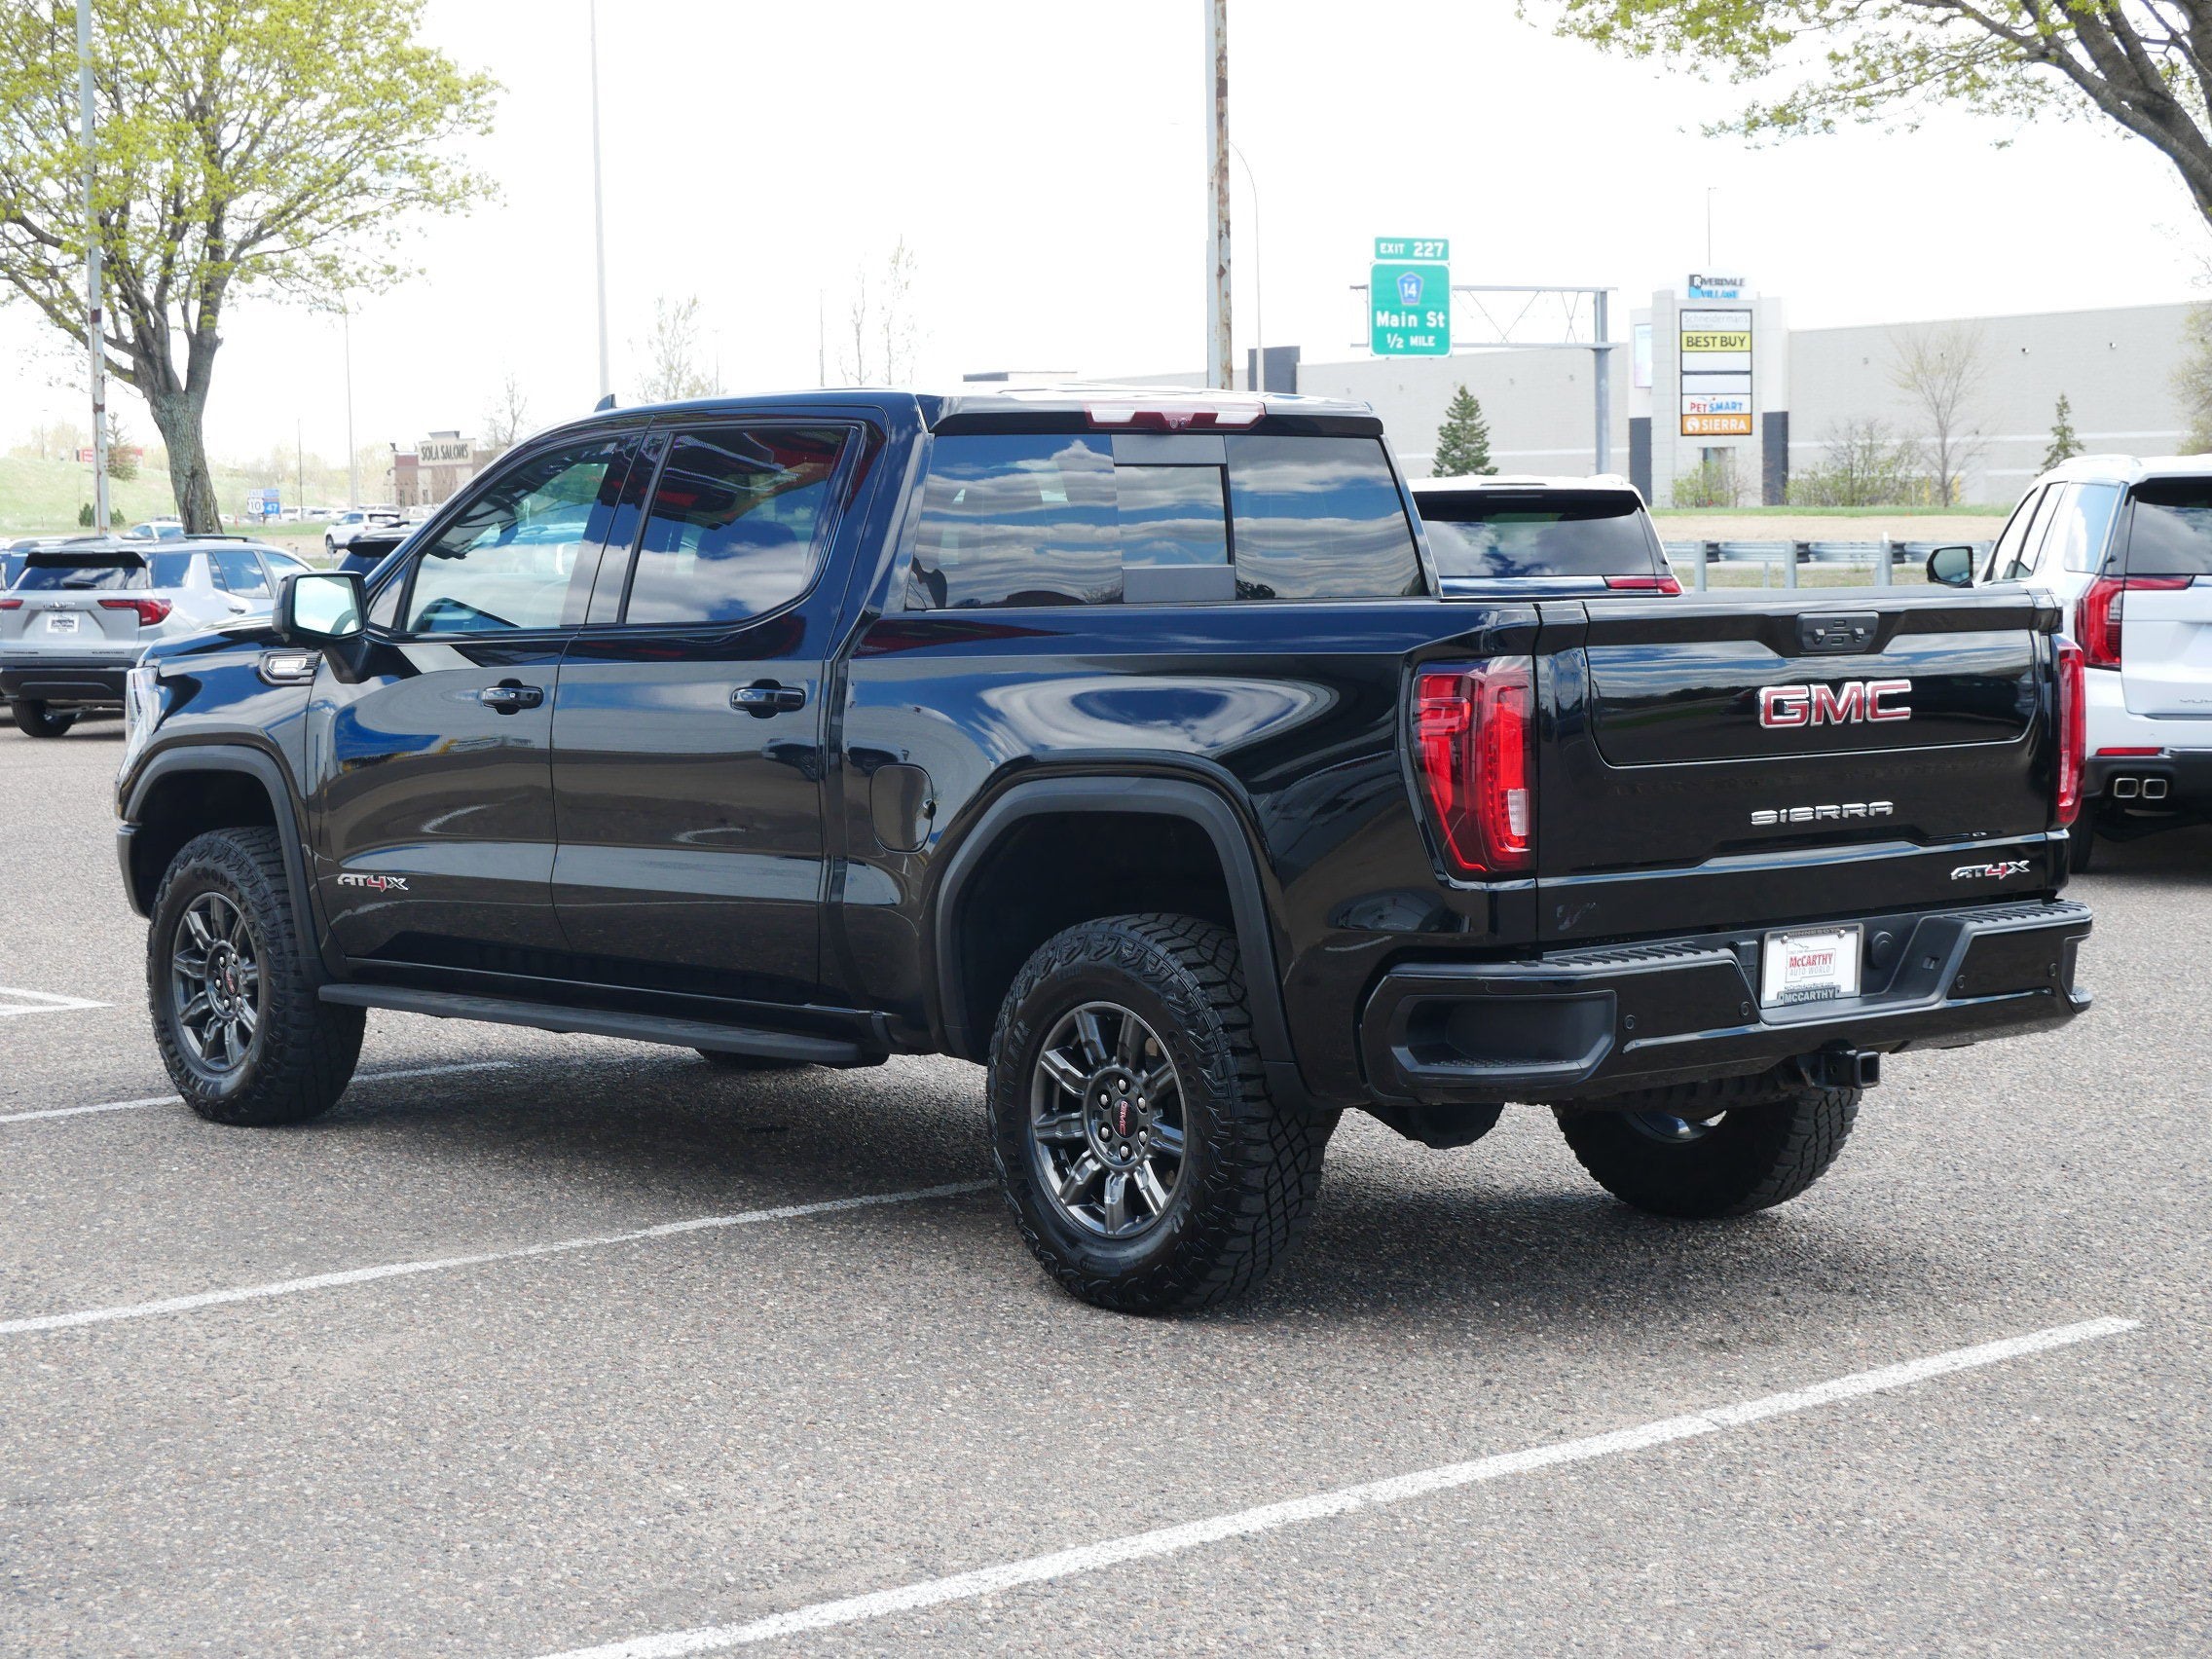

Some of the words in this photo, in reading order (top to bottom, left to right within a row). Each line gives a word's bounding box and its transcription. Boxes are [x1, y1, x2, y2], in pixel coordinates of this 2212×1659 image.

[1380, 242, 1405, 254] EXIT
[1413, 241, 1444, 257] 227
[1403, 282, 1418, 298] 14
[1376, 310, 1418, 327] Main
[1425, 311, 1445, 328] St
[1409, 335, 1435, 347] MILE
[1686, 336, 1717, 348] BEST
[1719, 336, 1747, 348] BUY
[1701, 419, 1747, 431] SIERRA
[421, 445, 440, 461] SOLA
[440, 443, 469, 461] SALONS
[250, 501, 261, 511] 10
[266, 503, 278, 513] 47
[1758, 679, 1912, 729] GMC
[1751, 800, 1894, 826] SIERRA
[1951, 860, 2030, 880] AT4X
[337, 872, 409, 893] AT4X
[1789, 952, 1833, 968] McCARTHY
[1789, 967, 1806, 977] AUTO
[1808, 965, 1831, 975] WORLD
[1119, 1100, 1128, 1136] GMC
